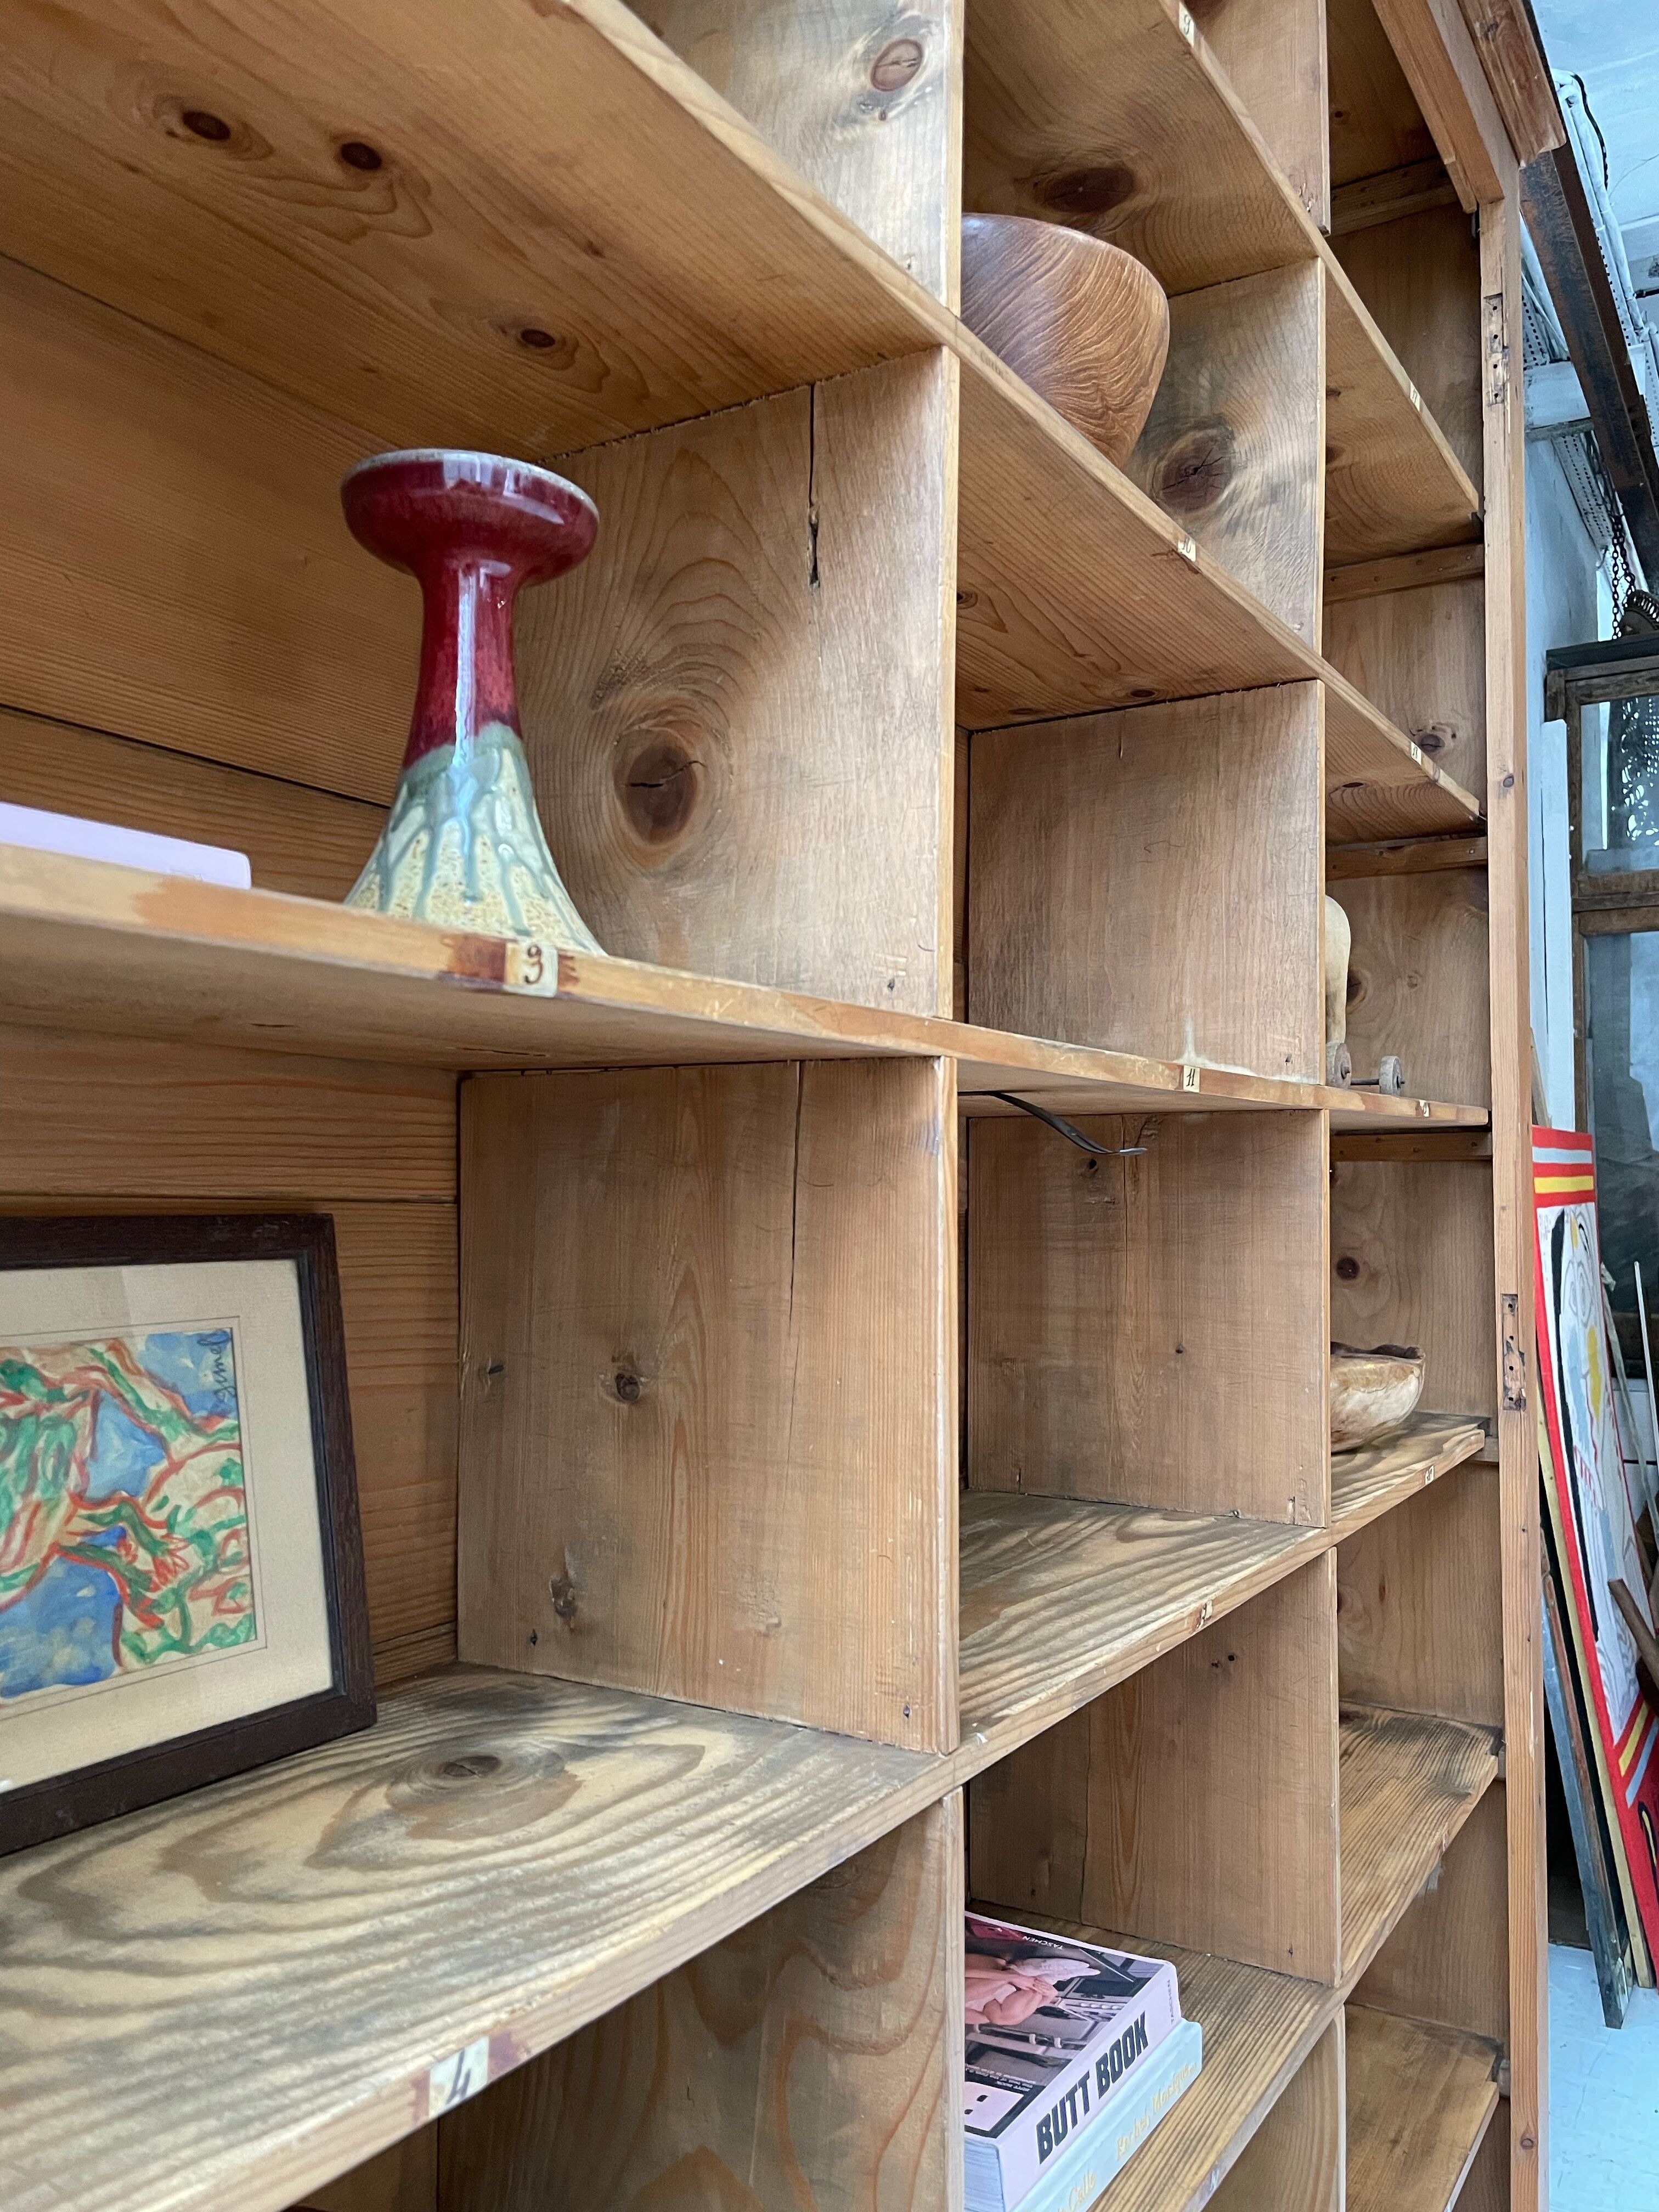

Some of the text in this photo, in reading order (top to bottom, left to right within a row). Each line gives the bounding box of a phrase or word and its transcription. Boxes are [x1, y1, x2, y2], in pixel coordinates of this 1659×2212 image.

[1186, 1068, 1195, 1087] 11
[1022, 1936, 1063, 1950] TASCHEN
[1036, 2010, 1149, 2165] BUTT BOOK
